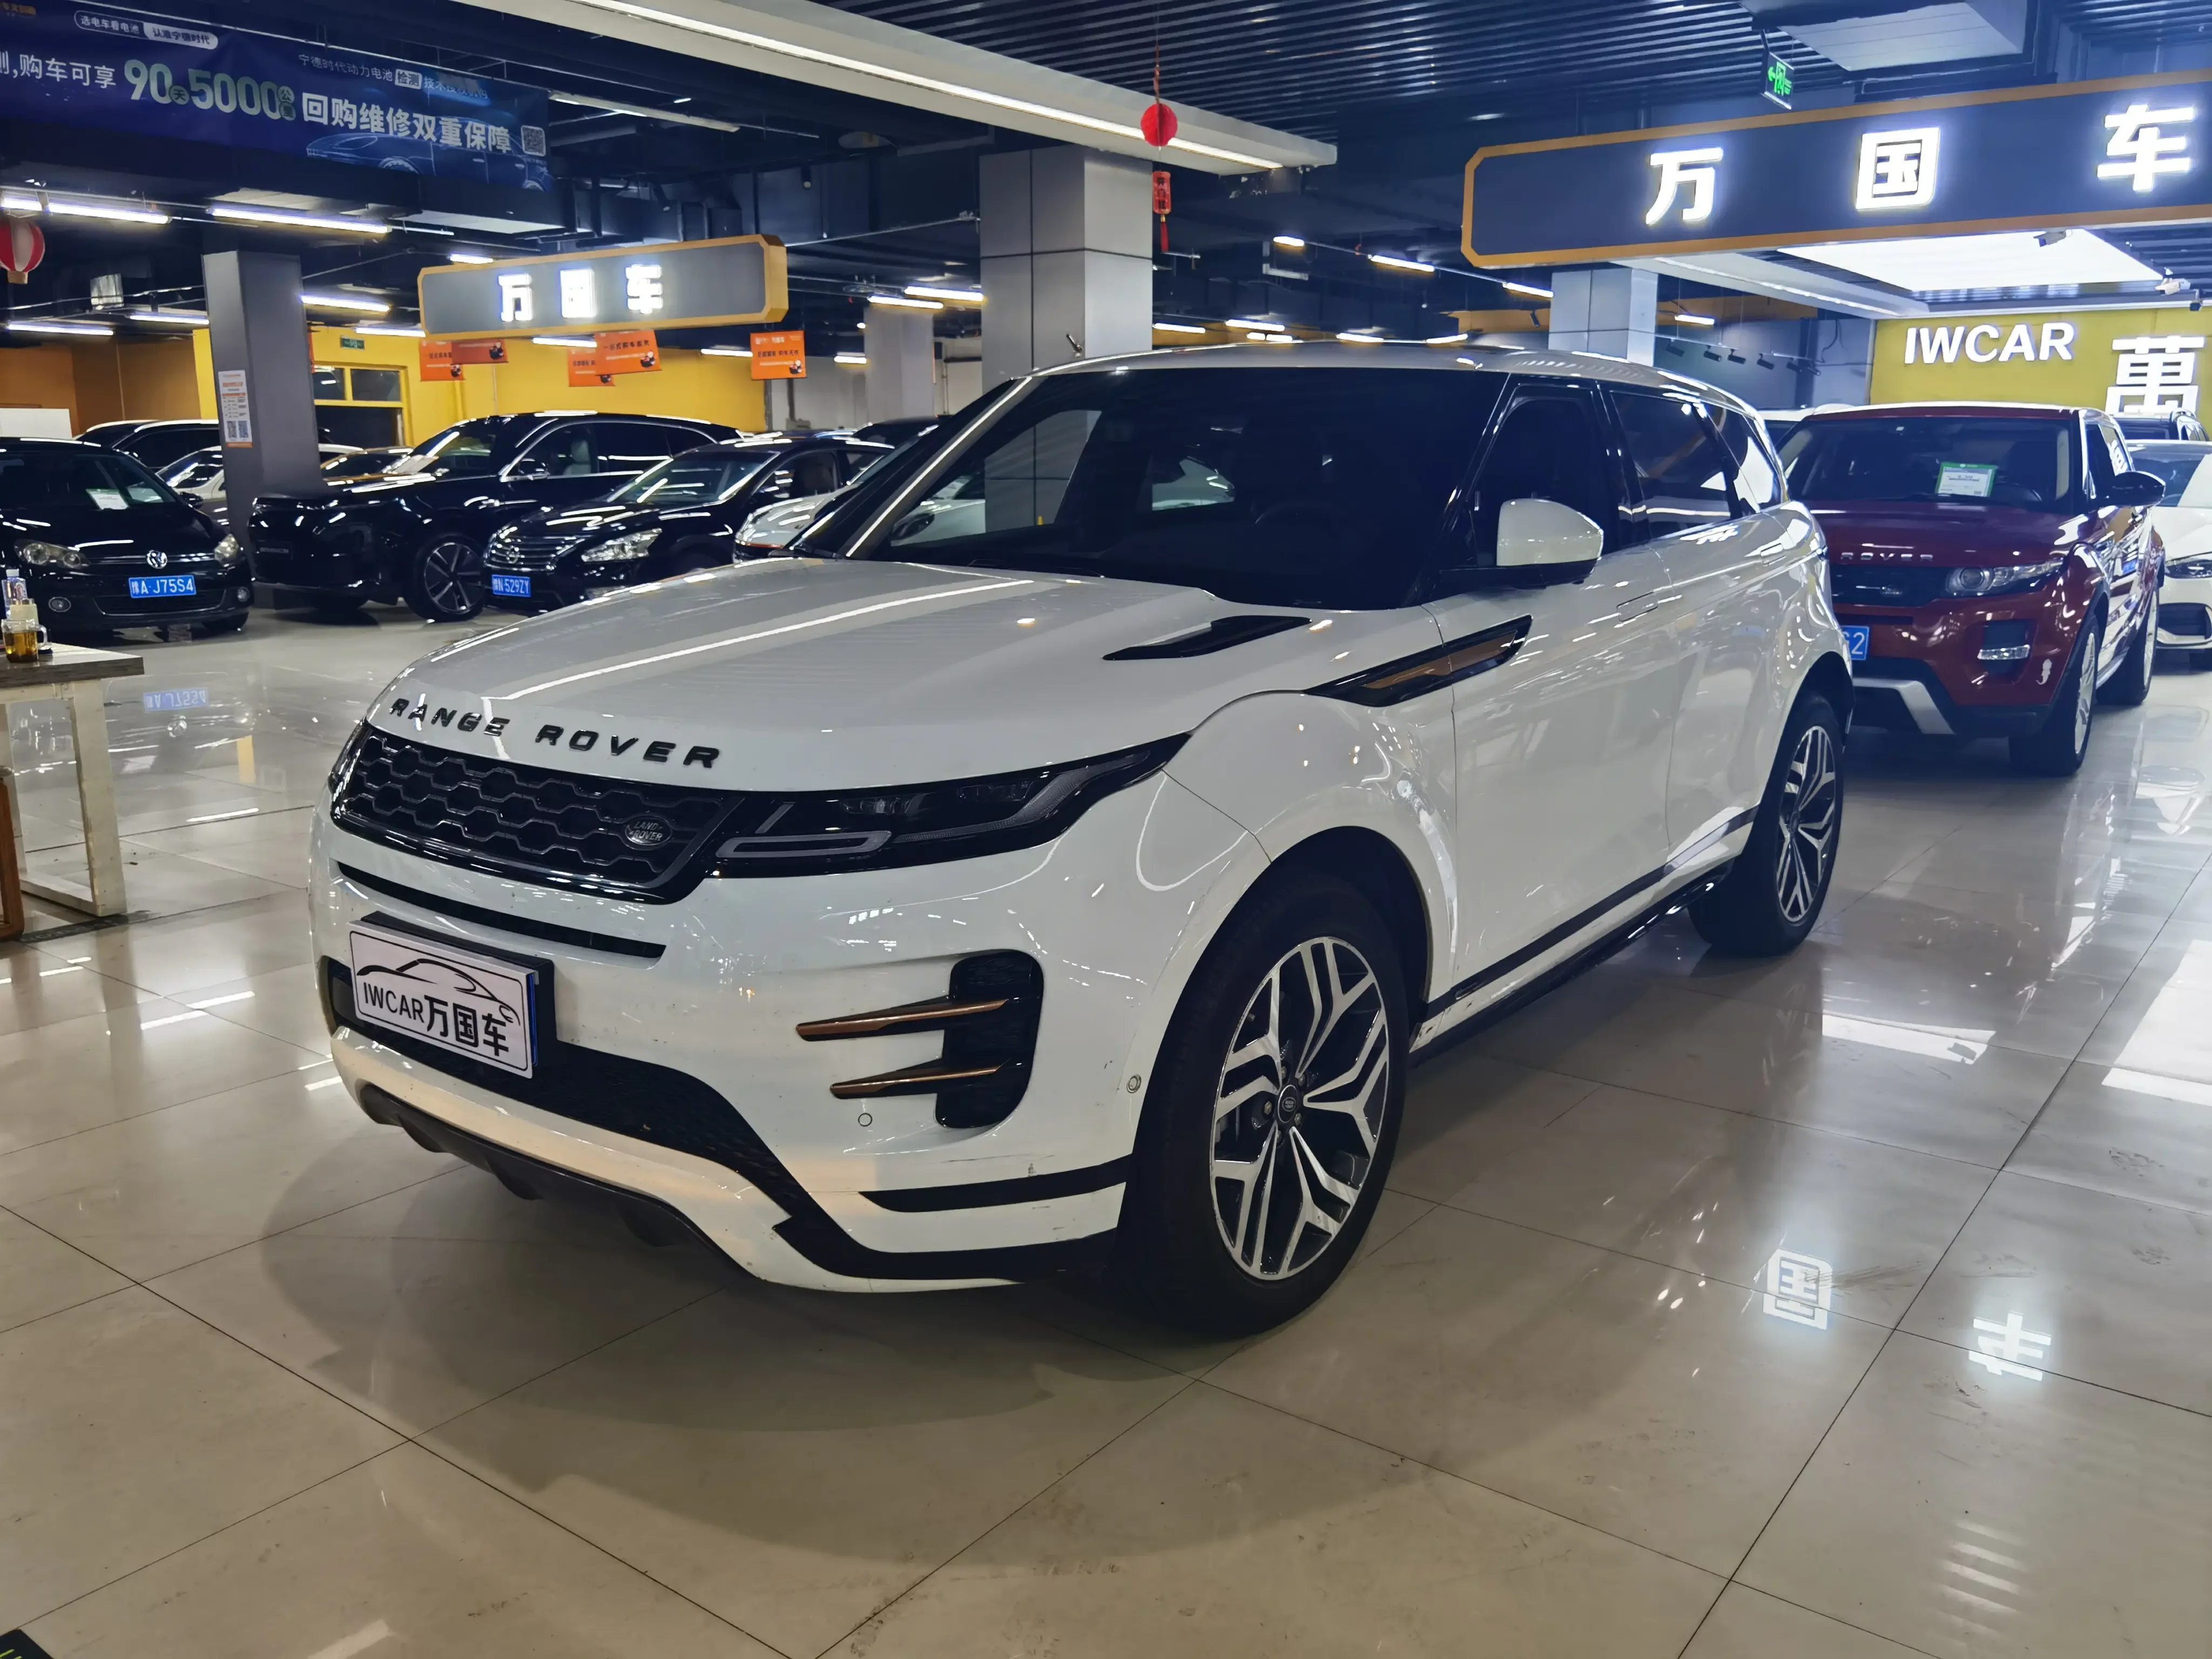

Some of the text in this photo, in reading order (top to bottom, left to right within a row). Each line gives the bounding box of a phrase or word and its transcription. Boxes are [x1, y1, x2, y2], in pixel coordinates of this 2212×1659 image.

[302, 92, 511, 153] 回购维修双重保障
[1904, 322, 2075, 365] IWCAR
[2105, 335, 2204, 415] 萬
[389, 698, 720, 768] RANGE ROVER
[632, 830, 663, 841] ROVER
[633, 821, 659, 831] LAND
[363, 981, 510, 1057] IWCAR万国车
